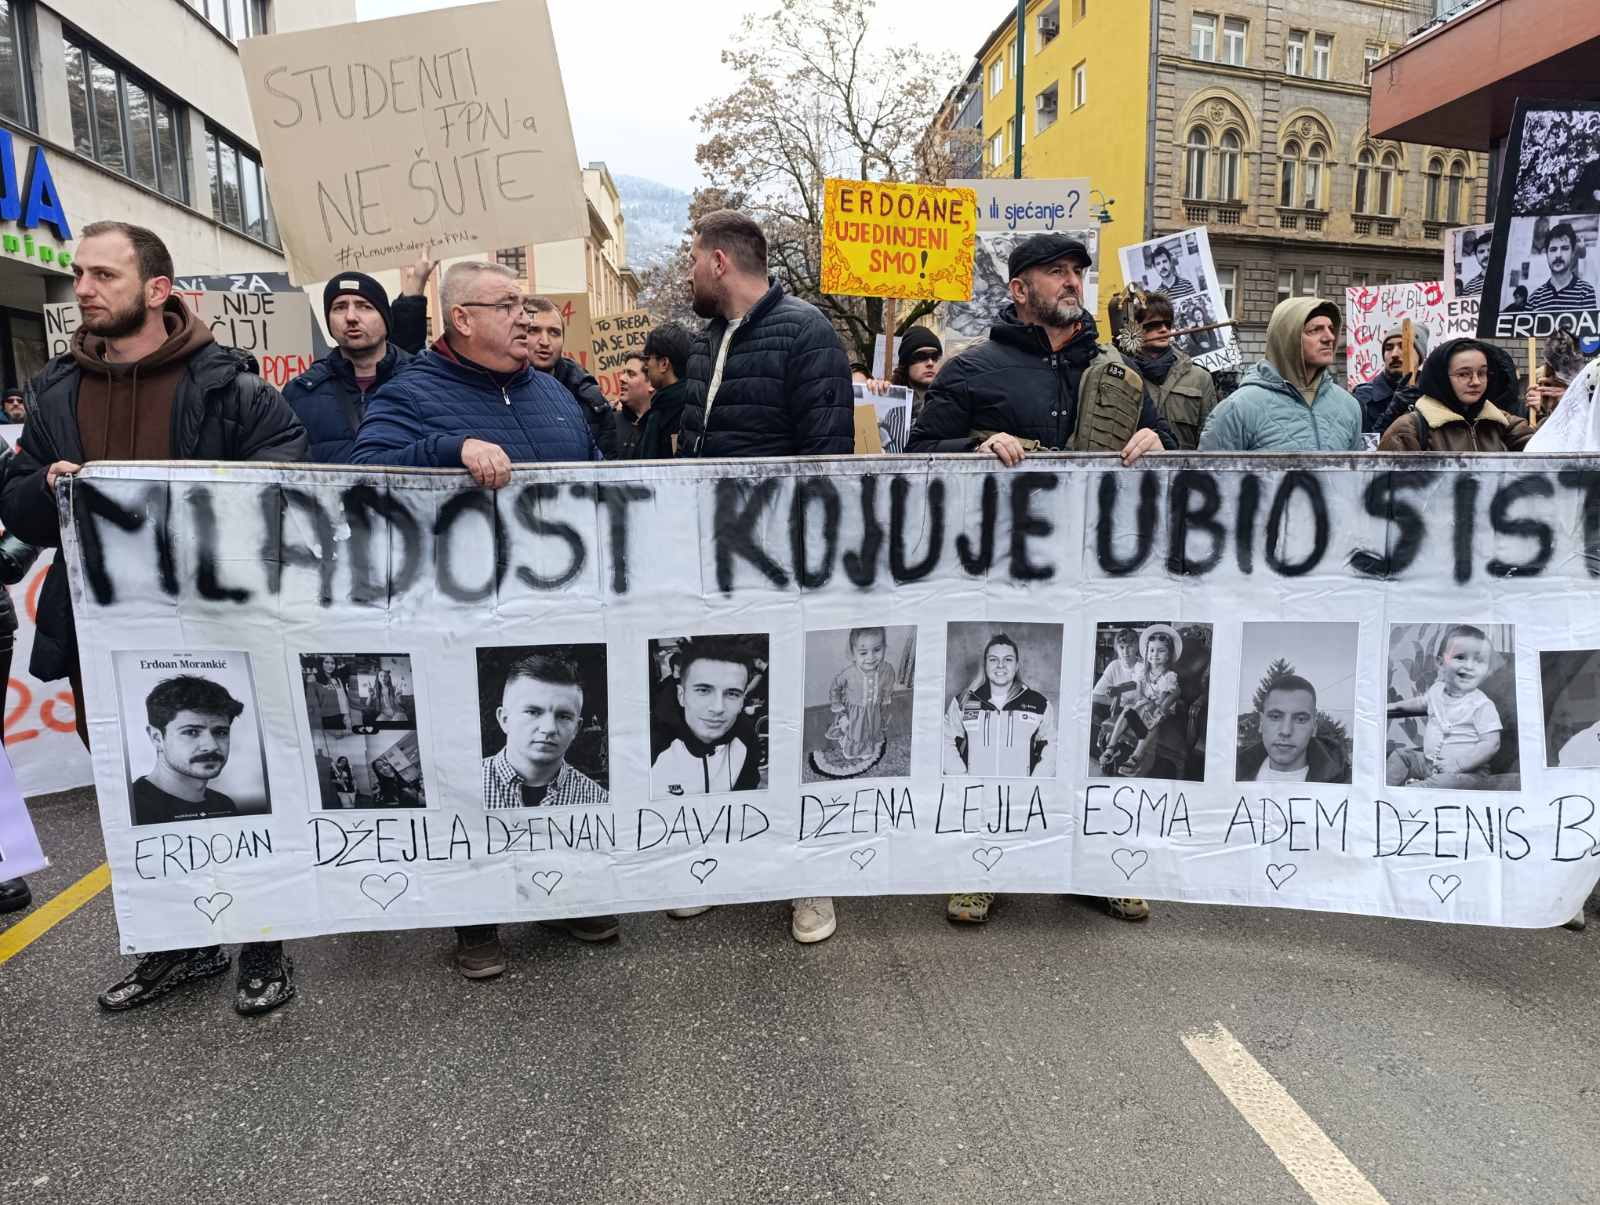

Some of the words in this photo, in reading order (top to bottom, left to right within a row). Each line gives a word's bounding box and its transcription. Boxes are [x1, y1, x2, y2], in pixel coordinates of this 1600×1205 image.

[263, 47, 479, 129] STUDENTI
[317, 164, 392, 244] NE
[408, 147, 543, 226] ŠUTE
[1004, 189, 1081, 231] sjećanje?
[835, 220, 949, 251] UJEDINJENI
[868, 249, 929, 280] SMO!
[229, 274, 272, 293] ZA
[222, 293, 275, 316] NIJE
[1447, 300, 1480, 317] ERD
[45, 306, 76, 335] NE
[595, 320, 610, 332] TO
[614, 314, 651, 331] TREBA
[1495, 310, 1600, 338] ERDOA
[592, 338, 608, 355] DA
[610, 335, 625, 350] SE
[626, 331, 650, 347] DES
[77, 480, 653, 606] MLADOST
[1096, 470, 1329, 578] UBIO
[140, 659, 178, 670] Erdoan
[179, 658, 228, 670] Morankić
[134, 829, 273, 880] ERDOAN
[307, 814, 472, 868] DŽEJLA
[636, 803, 771, 851] DAVID
[798, 788, 917, 842] DŽENA
[934, 783, 1049, 835] LEJLA
[1083, 785, 1192, 838] ESMA
[1224, 796, 1350, 853] ADEM
[1372, 800, 1531, 861] DŽENIS
